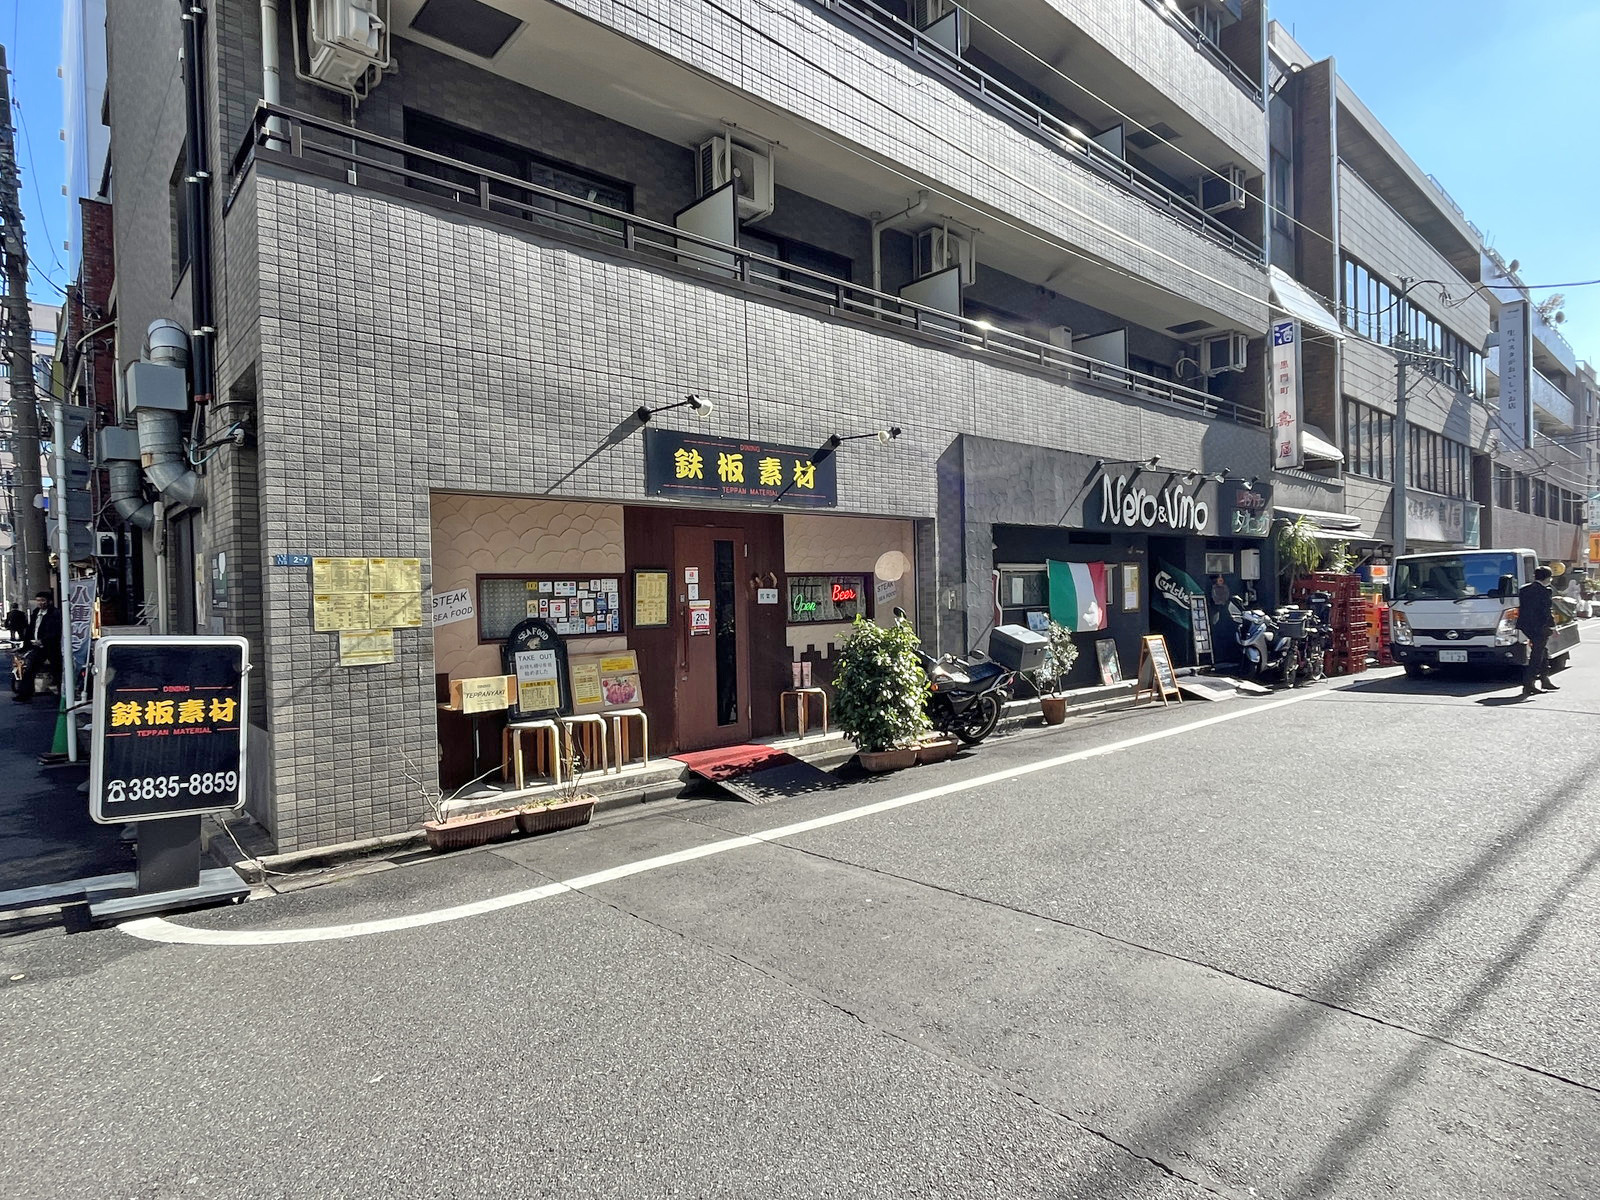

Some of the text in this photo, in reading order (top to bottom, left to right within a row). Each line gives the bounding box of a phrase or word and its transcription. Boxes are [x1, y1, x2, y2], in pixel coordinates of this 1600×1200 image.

[673, 447, 817, 489] 鉄板素材
[721, 486, 779, 498] TEPPAN MATERIAL
[293, 556, 308, 564] 2-7
[832, 584, 856, 600] Beer
[877, 582, 894, 592] STEAK
[432, 591, 468, 608] STEAK
[793, 594, 816, 613] Open
[433, 607, 473, 622] SEA FOOD
[518, 627, 549, 640] SEA FOOD
[466, 690, 505, 699] TEPPANYAKI
[111, 698, 237, 727] 鉄板素材
[137, 727, 212, 737] TEPPAN MATERIAL
[128, 771, 237, 801] 3835-8859
